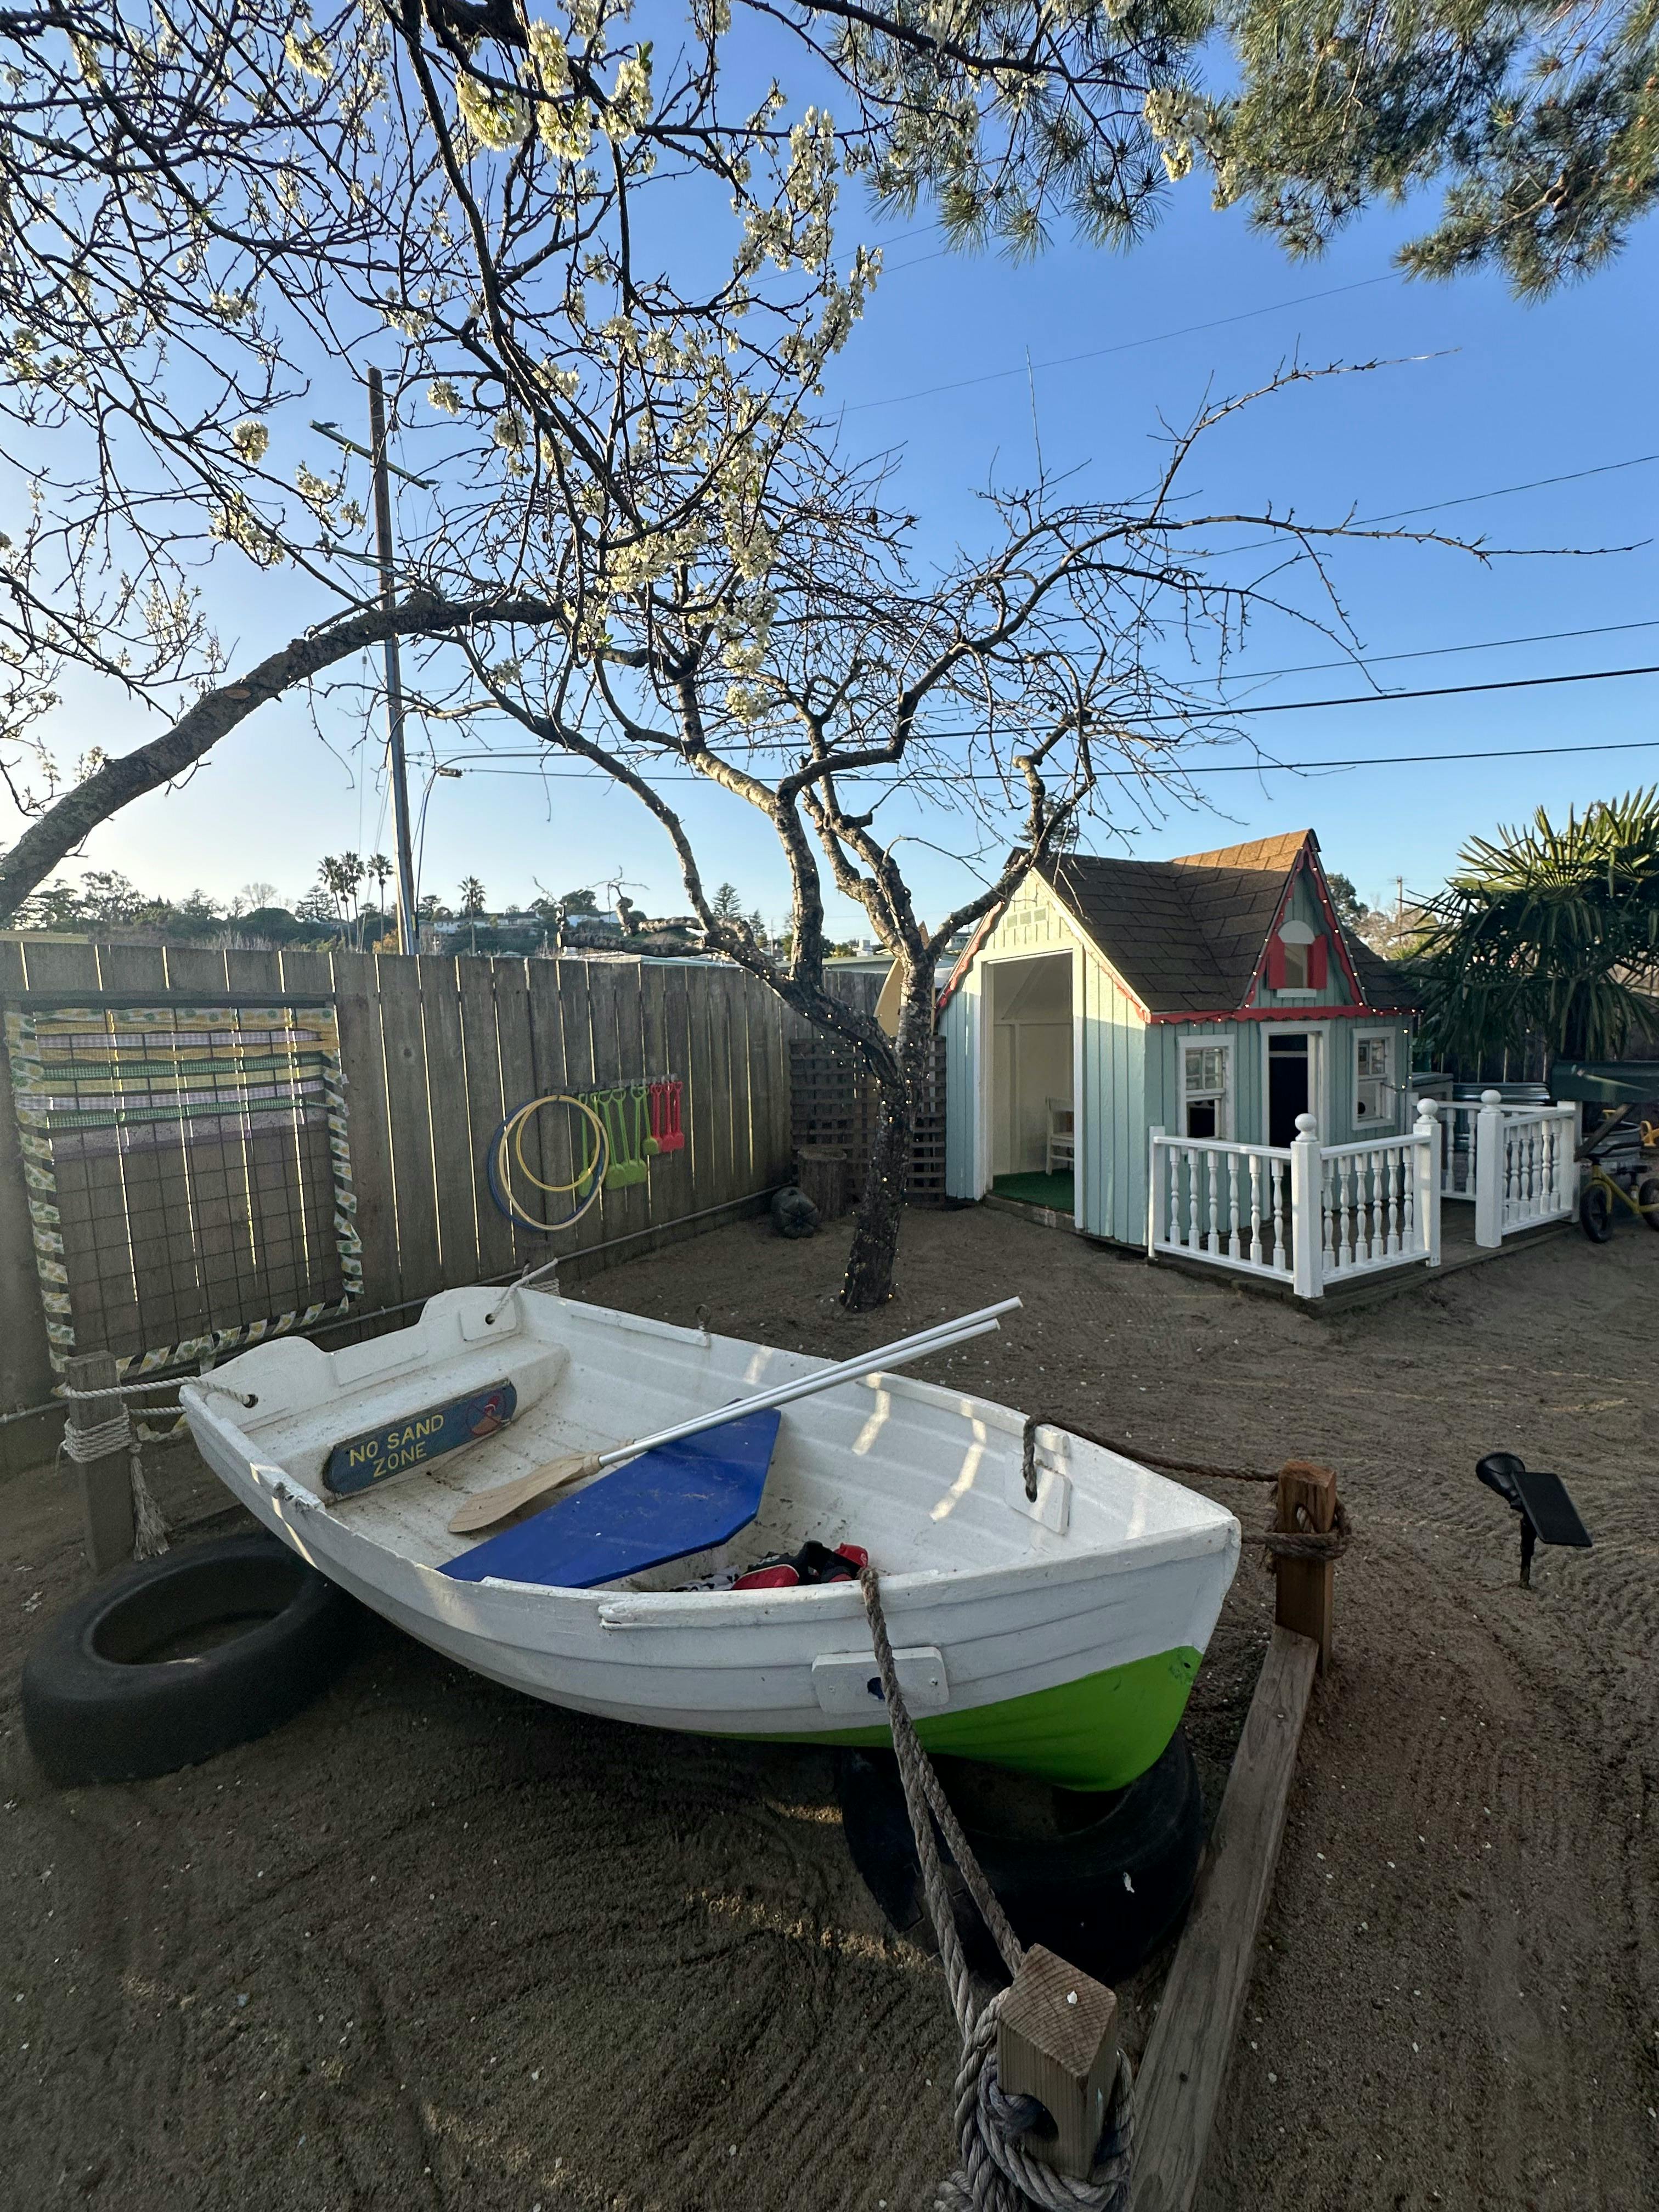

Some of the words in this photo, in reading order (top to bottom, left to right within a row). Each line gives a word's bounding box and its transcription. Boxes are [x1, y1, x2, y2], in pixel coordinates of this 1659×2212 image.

[349, 1441, 379, 1466] NO
[387, 1414, 444, 1449] SAND
[374, 1441, 427, 1477] ZONE
